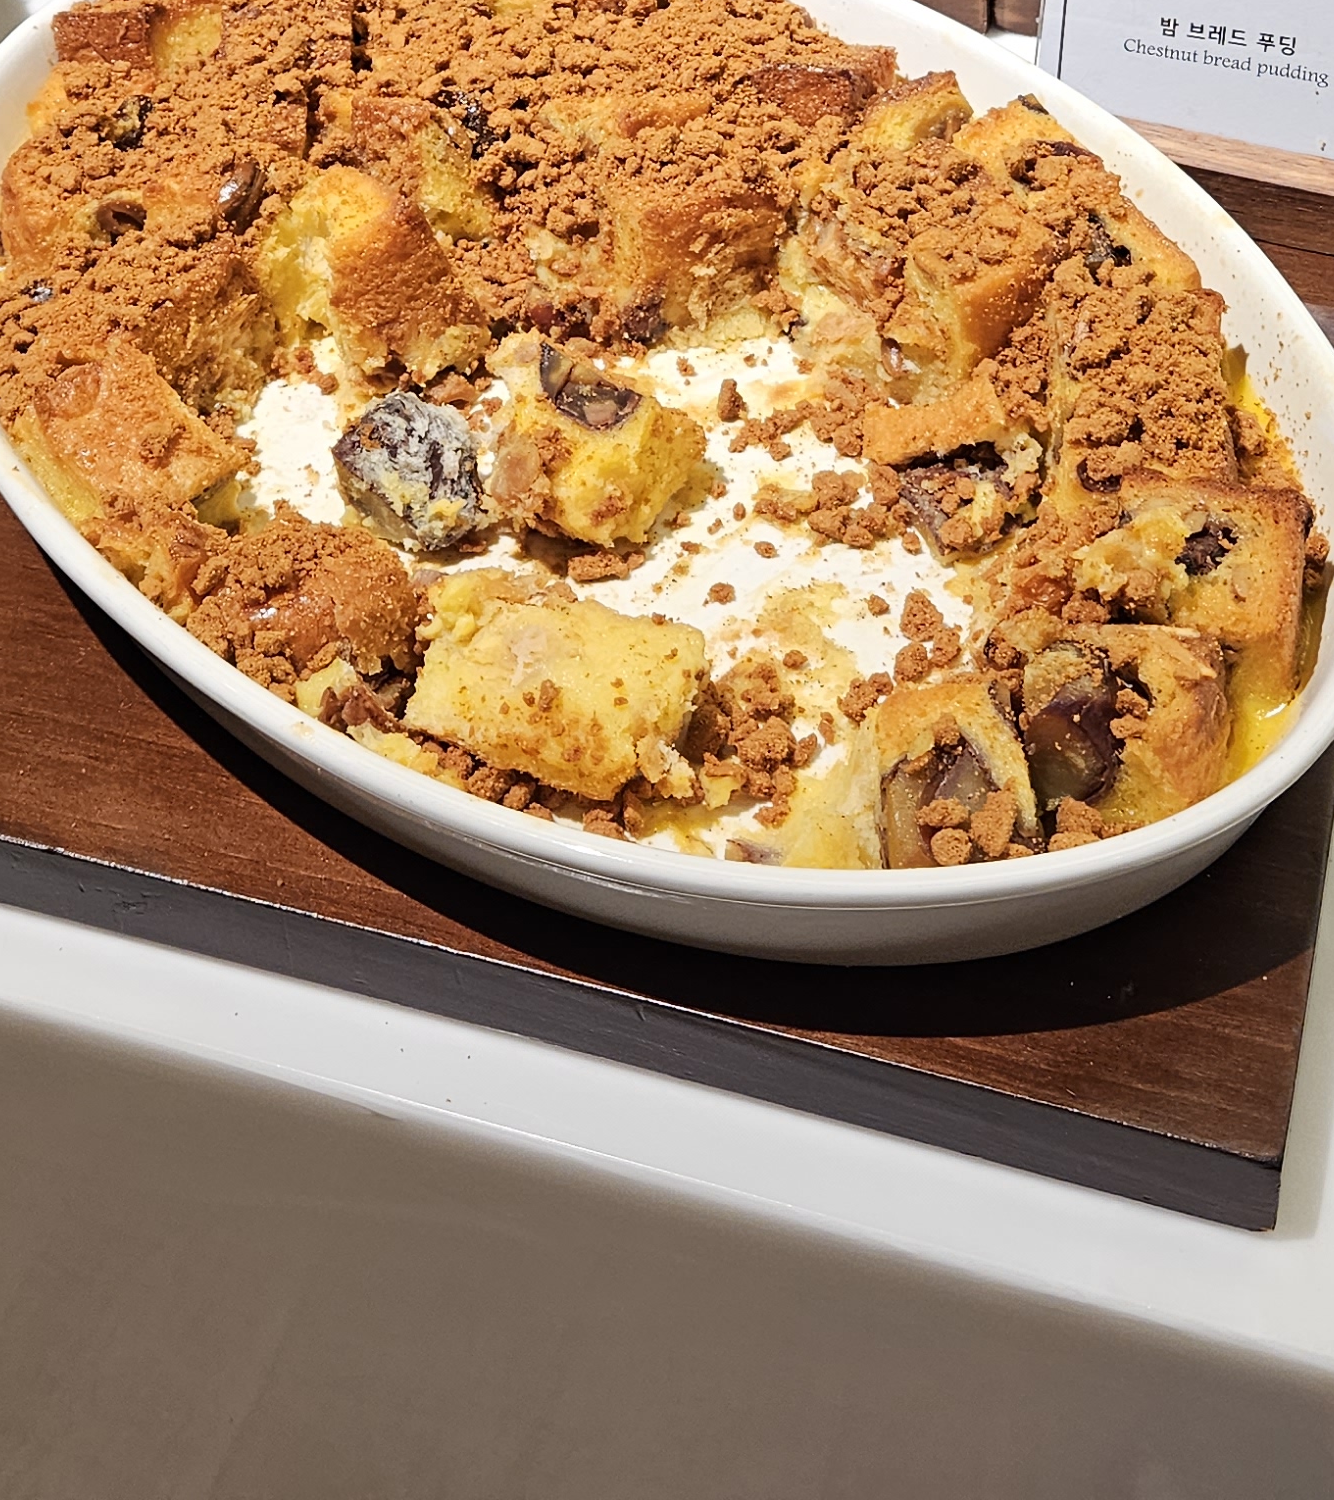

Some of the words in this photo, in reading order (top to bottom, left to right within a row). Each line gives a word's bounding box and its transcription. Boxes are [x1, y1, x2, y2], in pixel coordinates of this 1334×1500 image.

[1160, 17, 1180, 38] 밤
[1186, 22, 1248, 46] 브레드
[1256, 32, 1298, 57] 푸딩
[1123, 37, 1199, 63] Chestnut
[1203, 50, 1252, 72] bread
[1256, 60, 1330, 88] pudding
